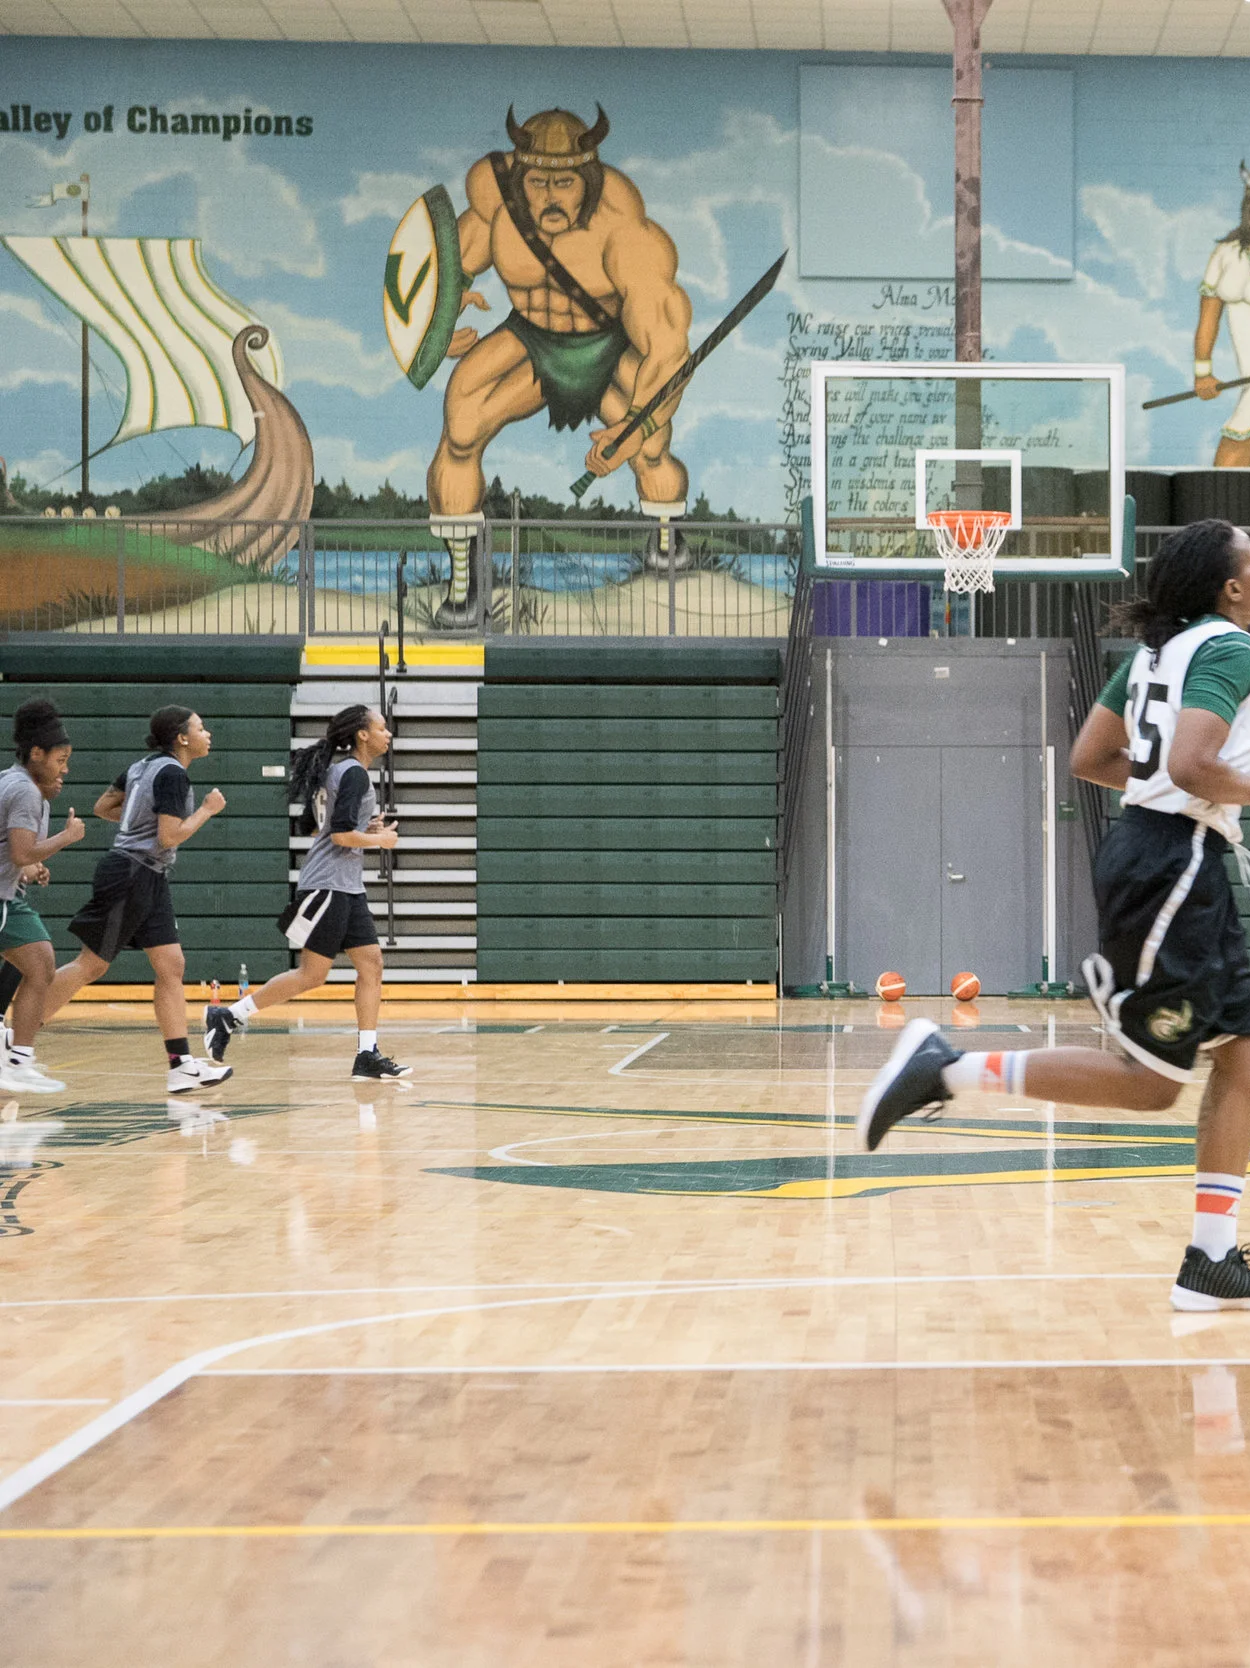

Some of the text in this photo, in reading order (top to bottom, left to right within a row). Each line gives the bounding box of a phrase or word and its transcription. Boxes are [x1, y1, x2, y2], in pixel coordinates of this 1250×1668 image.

[84, 105, 114, 132] of
[127, 105, 314, 141] Champions
[872, 284, 917, 309] Alma
[787, 335, 829, 360] Spring
[832, 335, 874, 361] Valley
[876, 335, 909, 361] High
[914, 341, 925, 360] to
[927, 347, 952, 361] your
[783, 378, 806, 402] The
[854, 402, 873, 427] of
[848, 489, 868, 512] the
[873, 490, 908, 513] colors
